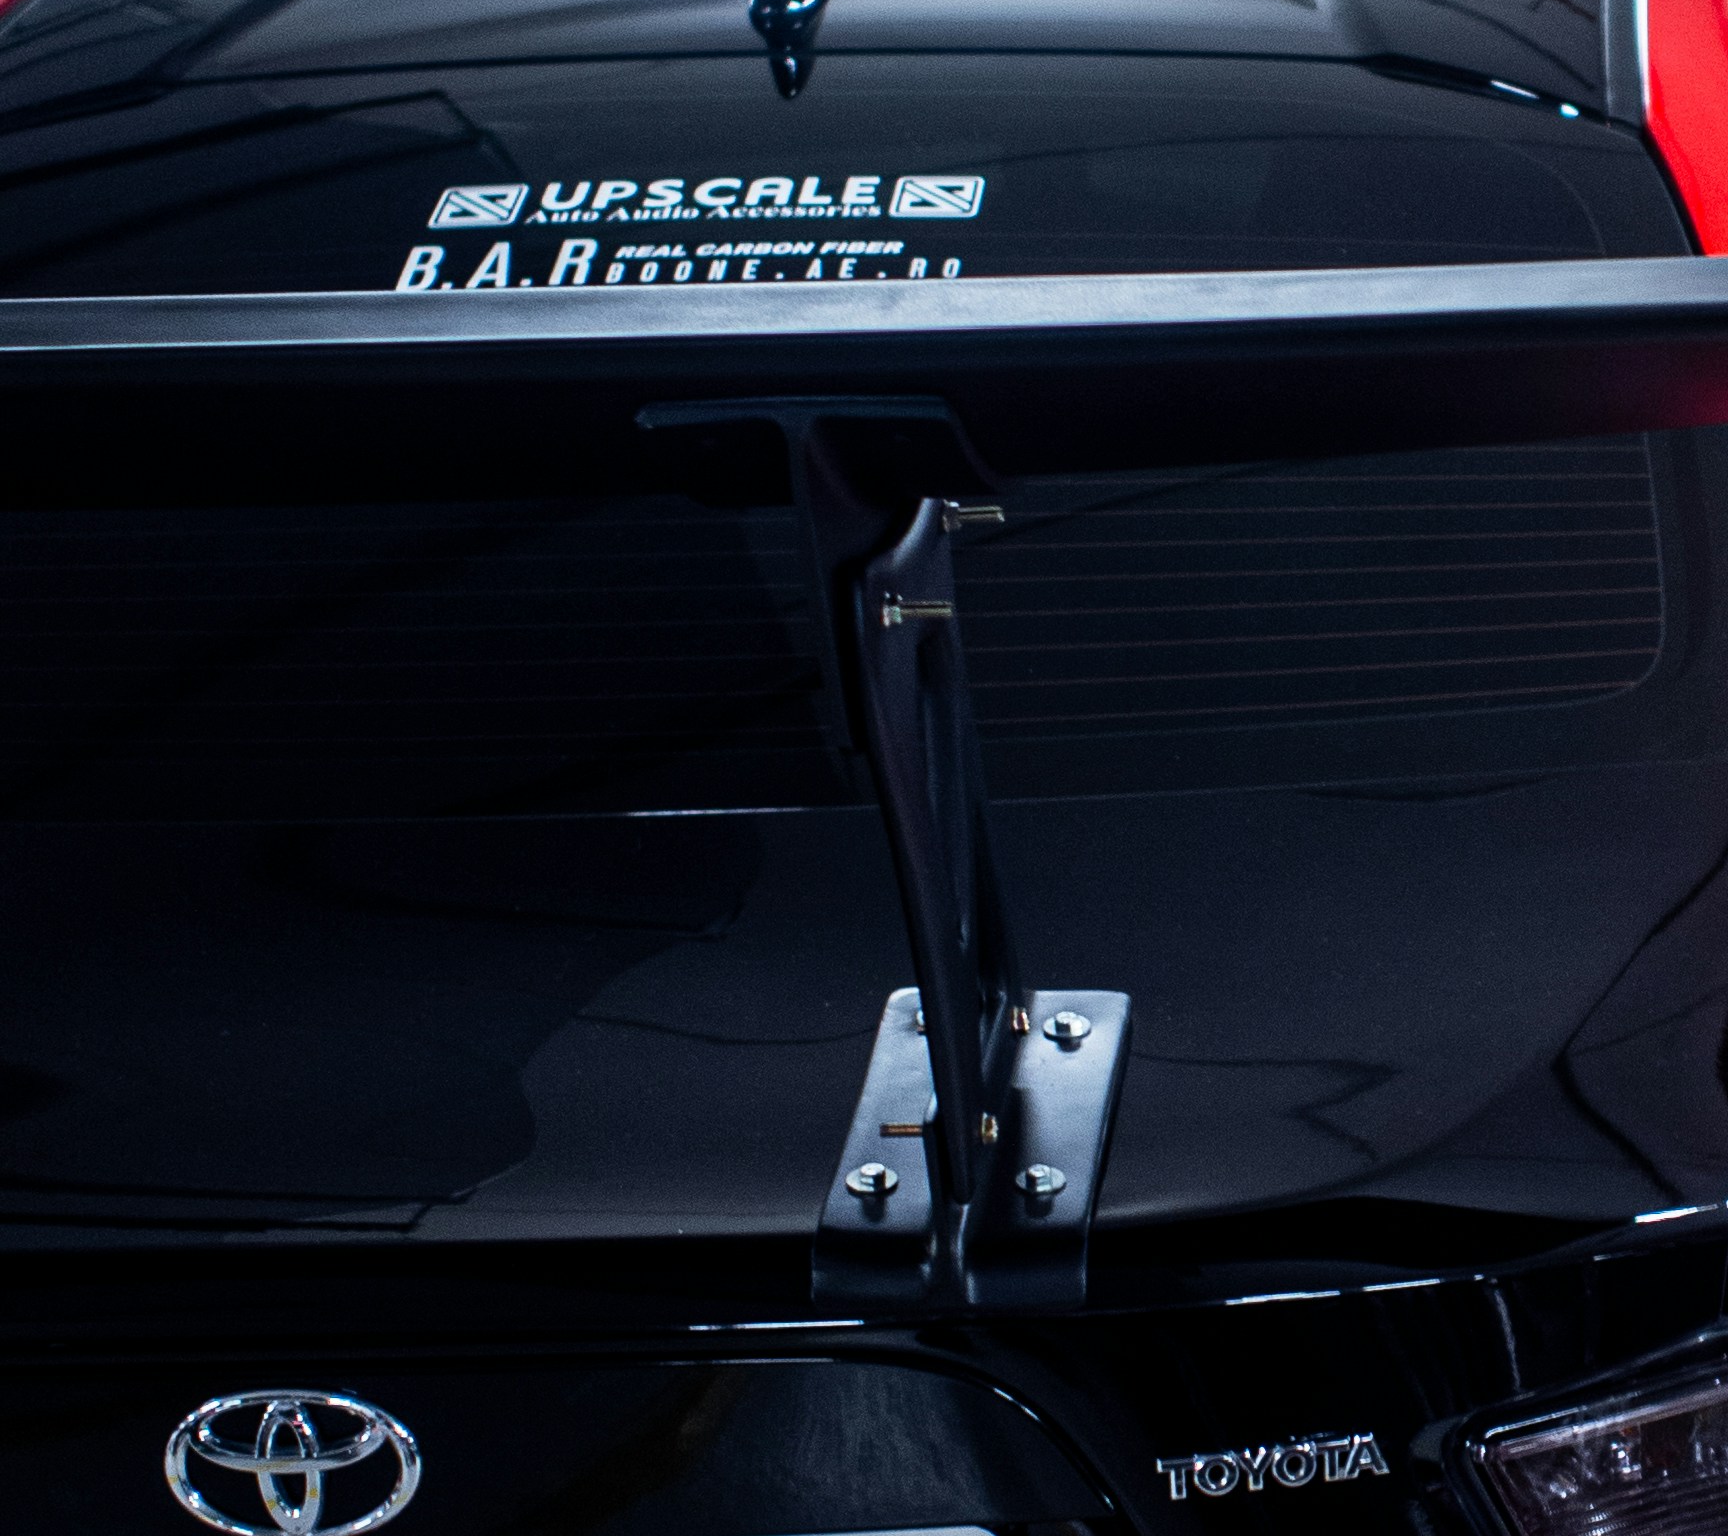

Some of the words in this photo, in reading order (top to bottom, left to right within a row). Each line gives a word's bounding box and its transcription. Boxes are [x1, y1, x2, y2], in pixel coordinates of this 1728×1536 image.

[540, 176, 881, 210] UPSCALE
[524, 208, 600, 224] Auto
[606, 205, 700, 222] Audio
[706, 203, 882, 220] Accessories
[615, 244, 687, 259] REAL
[696, 242, 815, 257] CARBON
[820, 240, 905, 255] FIBER
[1156, 1432, 1390, 1501] TOYOTA
